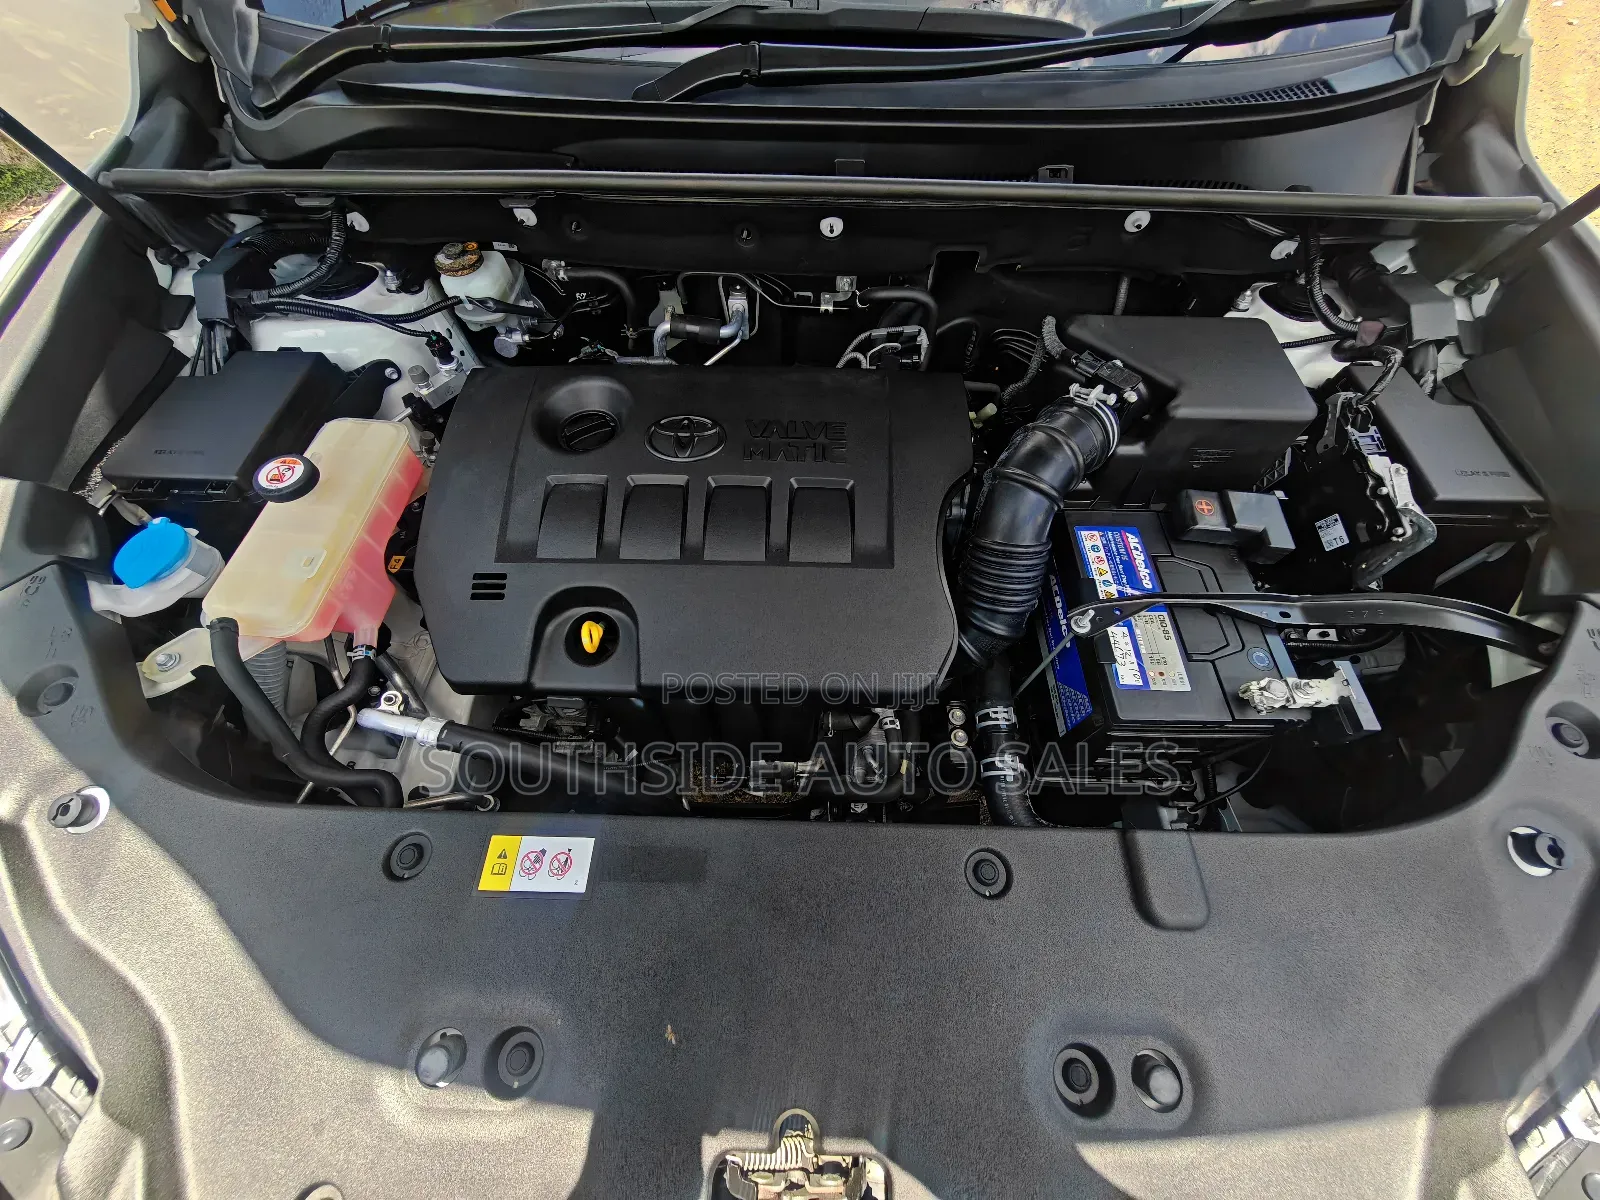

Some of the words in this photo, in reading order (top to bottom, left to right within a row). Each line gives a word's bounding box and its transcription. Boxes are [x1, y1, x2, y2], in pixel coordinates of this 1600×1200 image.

[744, 419, 848, 441] VALVE
[743, 441, 848, 465] MATIC
[1125, 532, 1153, 589] ACDelco
